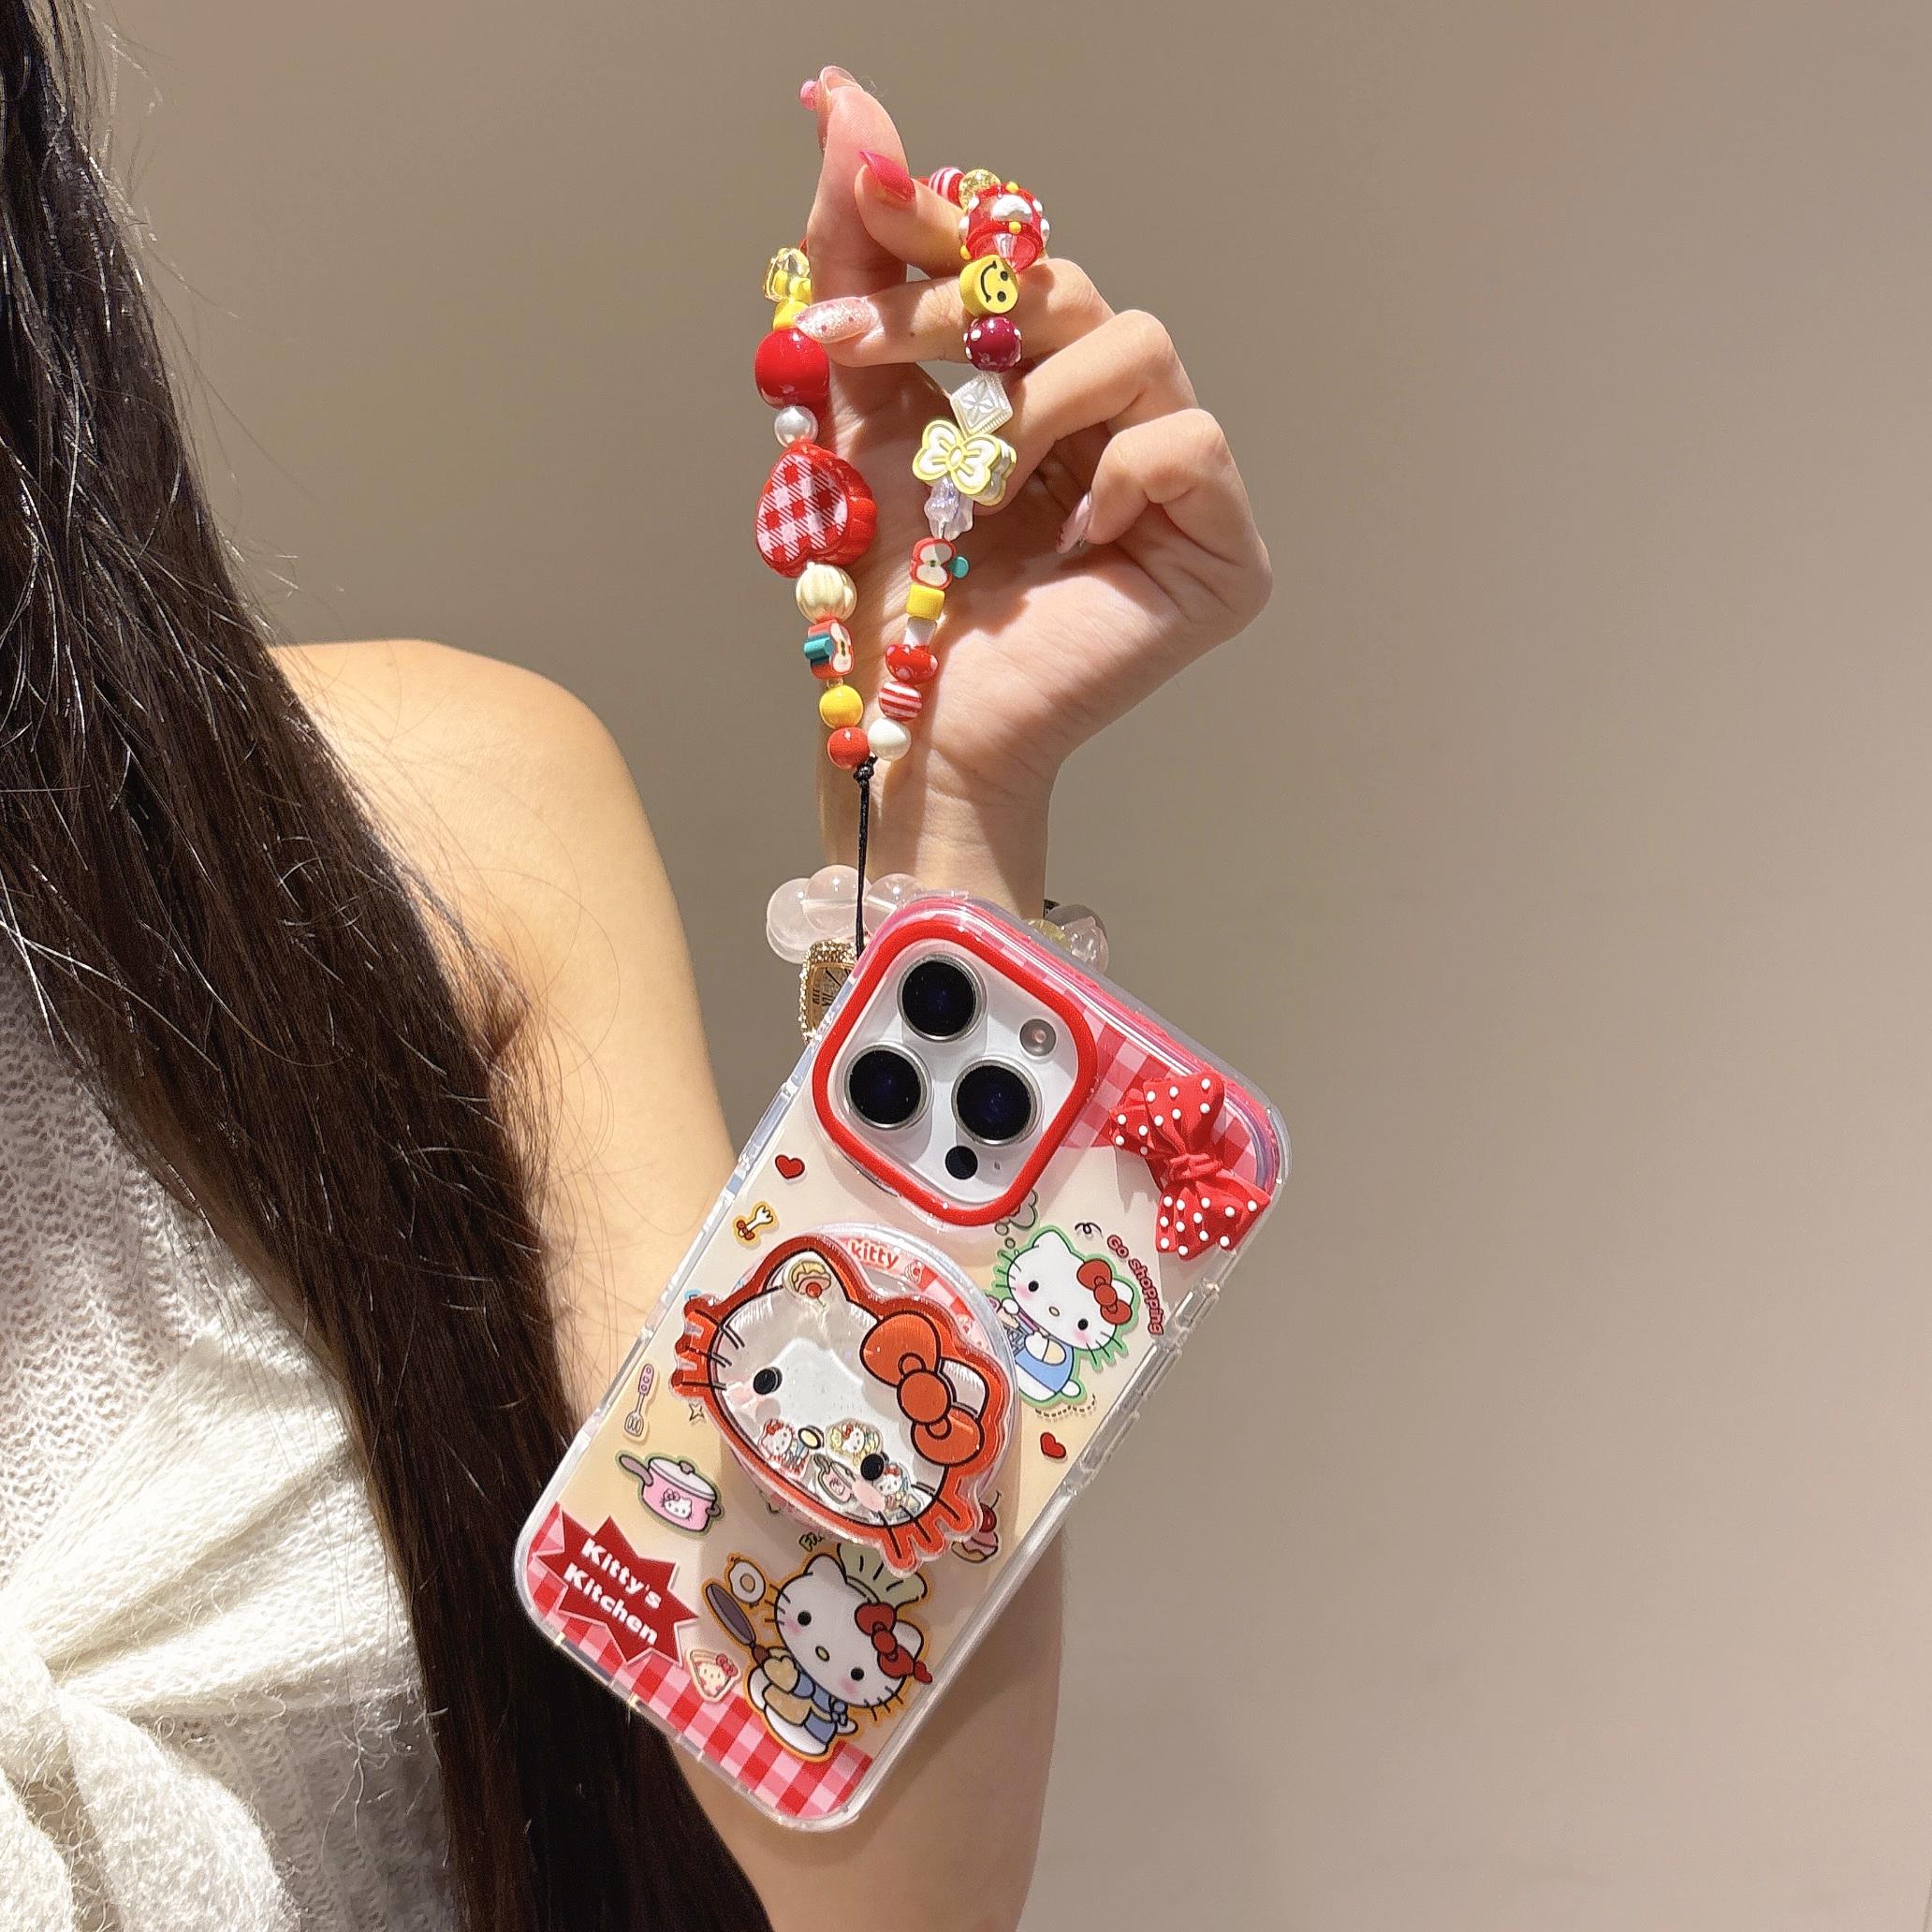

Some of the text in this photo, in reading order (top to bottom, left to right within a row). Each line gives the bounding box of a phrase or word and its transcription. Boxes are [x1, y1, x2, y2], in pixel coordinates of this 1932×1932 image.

[1106, 1235, 1164, 1335] Go shopping
[563, 1562, 658, 1645] Kitchen
[580, 1537, 662, 1609] Kitty's
